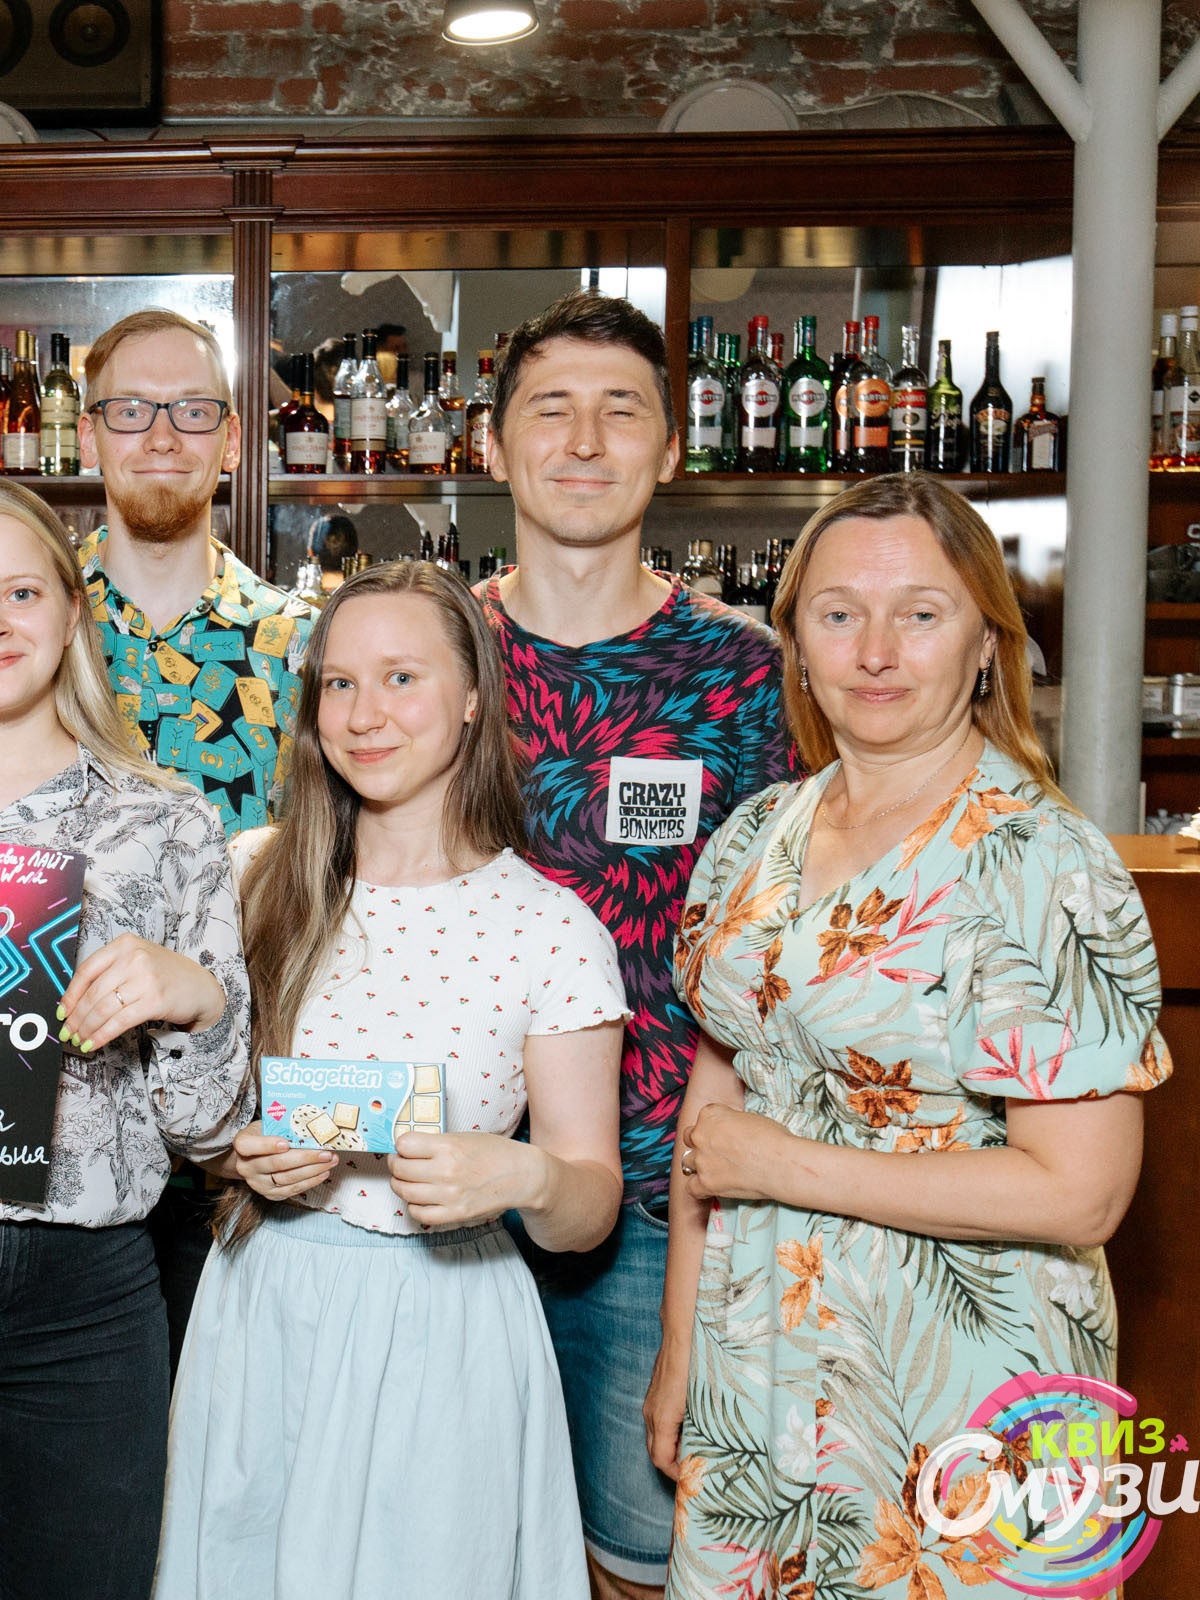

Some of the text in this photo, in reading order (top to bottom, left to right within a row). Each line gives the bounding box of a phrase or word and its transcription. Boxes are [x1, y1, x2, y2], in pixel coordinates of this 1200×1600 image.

[619, 781, 686, 807] CRAZY
[619, 817, 685, 840] BONKERS
[27, 850, 75, 871] ЛАЙТ
[264, 1061, 383, 1092] Schogetten
